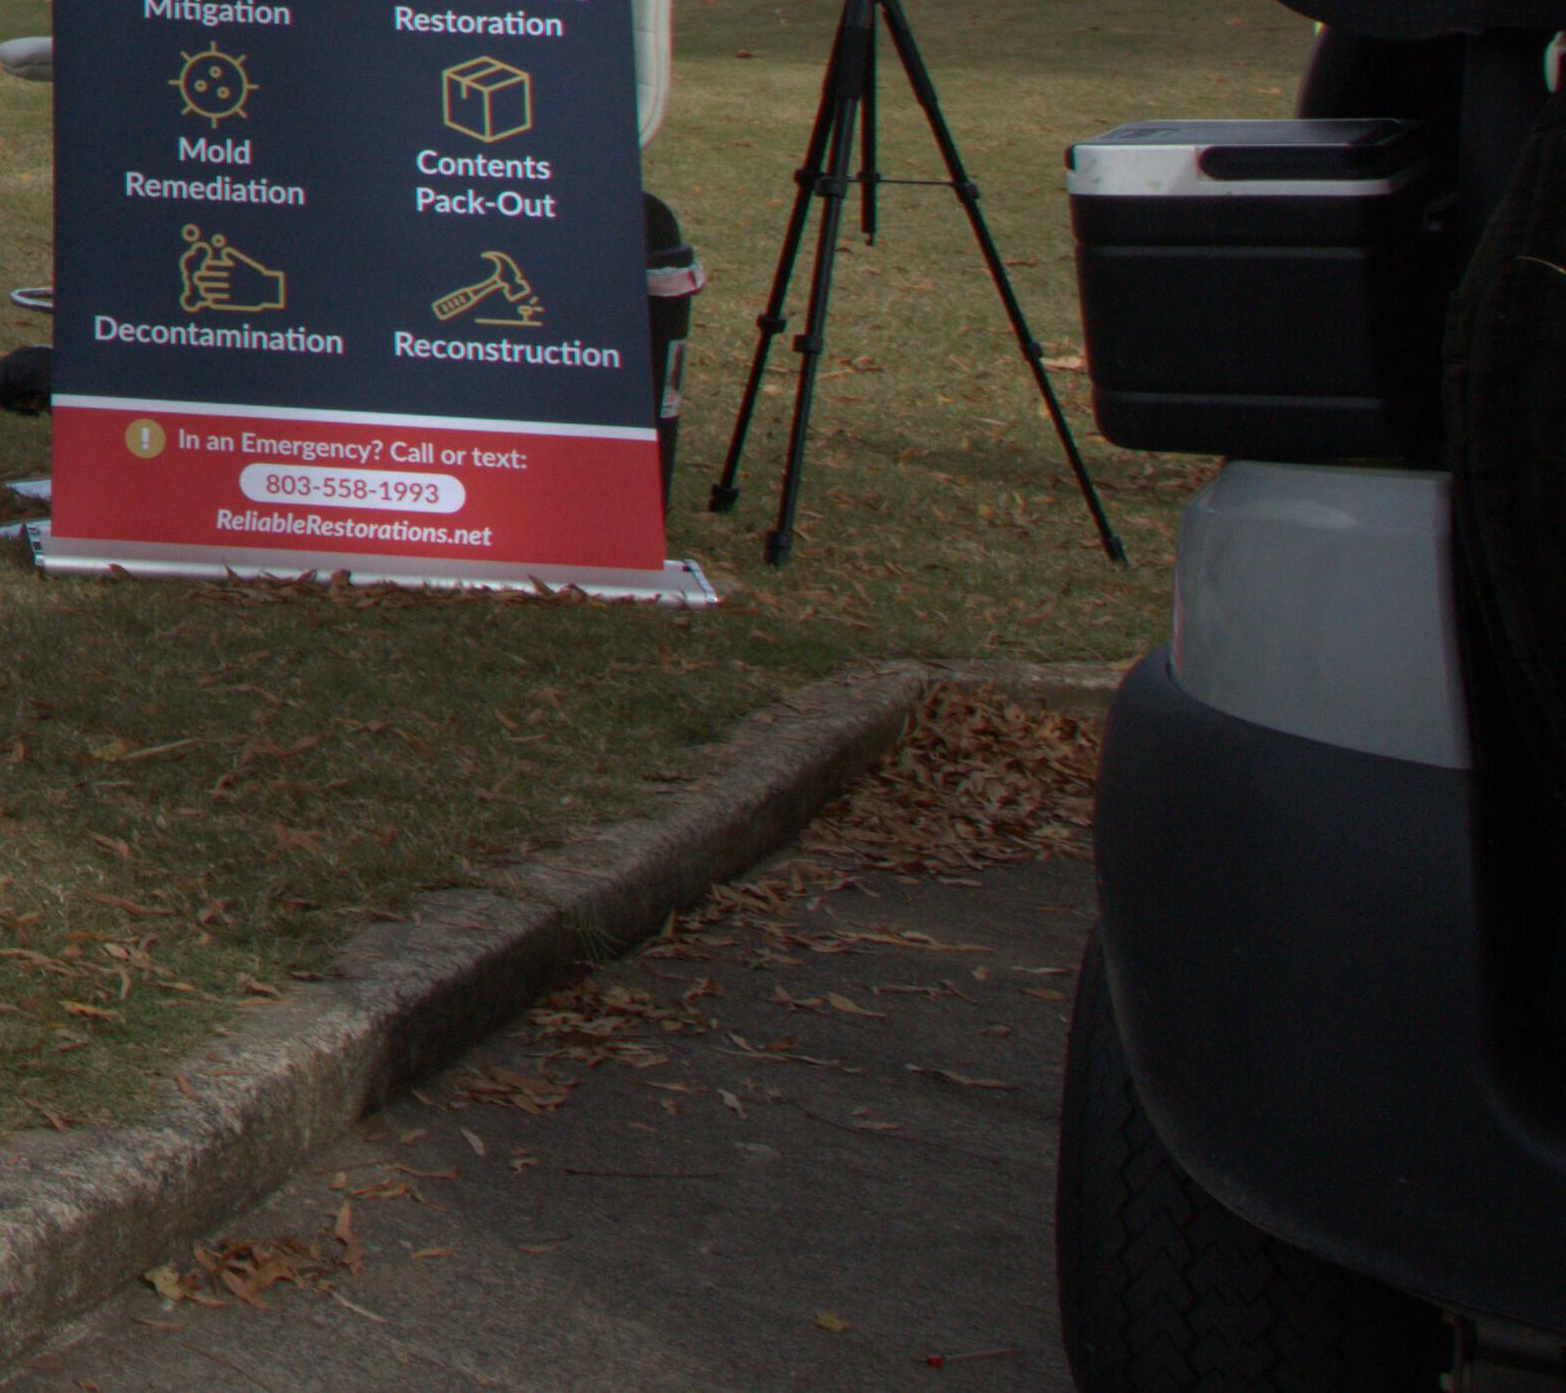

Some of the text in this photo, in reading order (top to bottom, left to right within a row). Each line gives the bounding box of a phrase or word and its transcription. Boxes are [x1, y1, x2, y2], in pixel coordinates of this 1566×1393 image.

[395, 7, 563, 37] Restoration
[179, 138, 251, 165] Mold
[417, 150, 550, 180] Contents
[126, 173, 305, 205] Remediation
[416, 188, 555, 218] Pack-Out
[95, 316, 344, 354] Decontamination
[394, 331, 619, 369] Reconstruction
[179, 429, 527, 469] In an Emergency? Call or text:
[266, 475, 439, 505] 803-558-1993
[217, 510, 491, 546] ReliableRestorations.net
